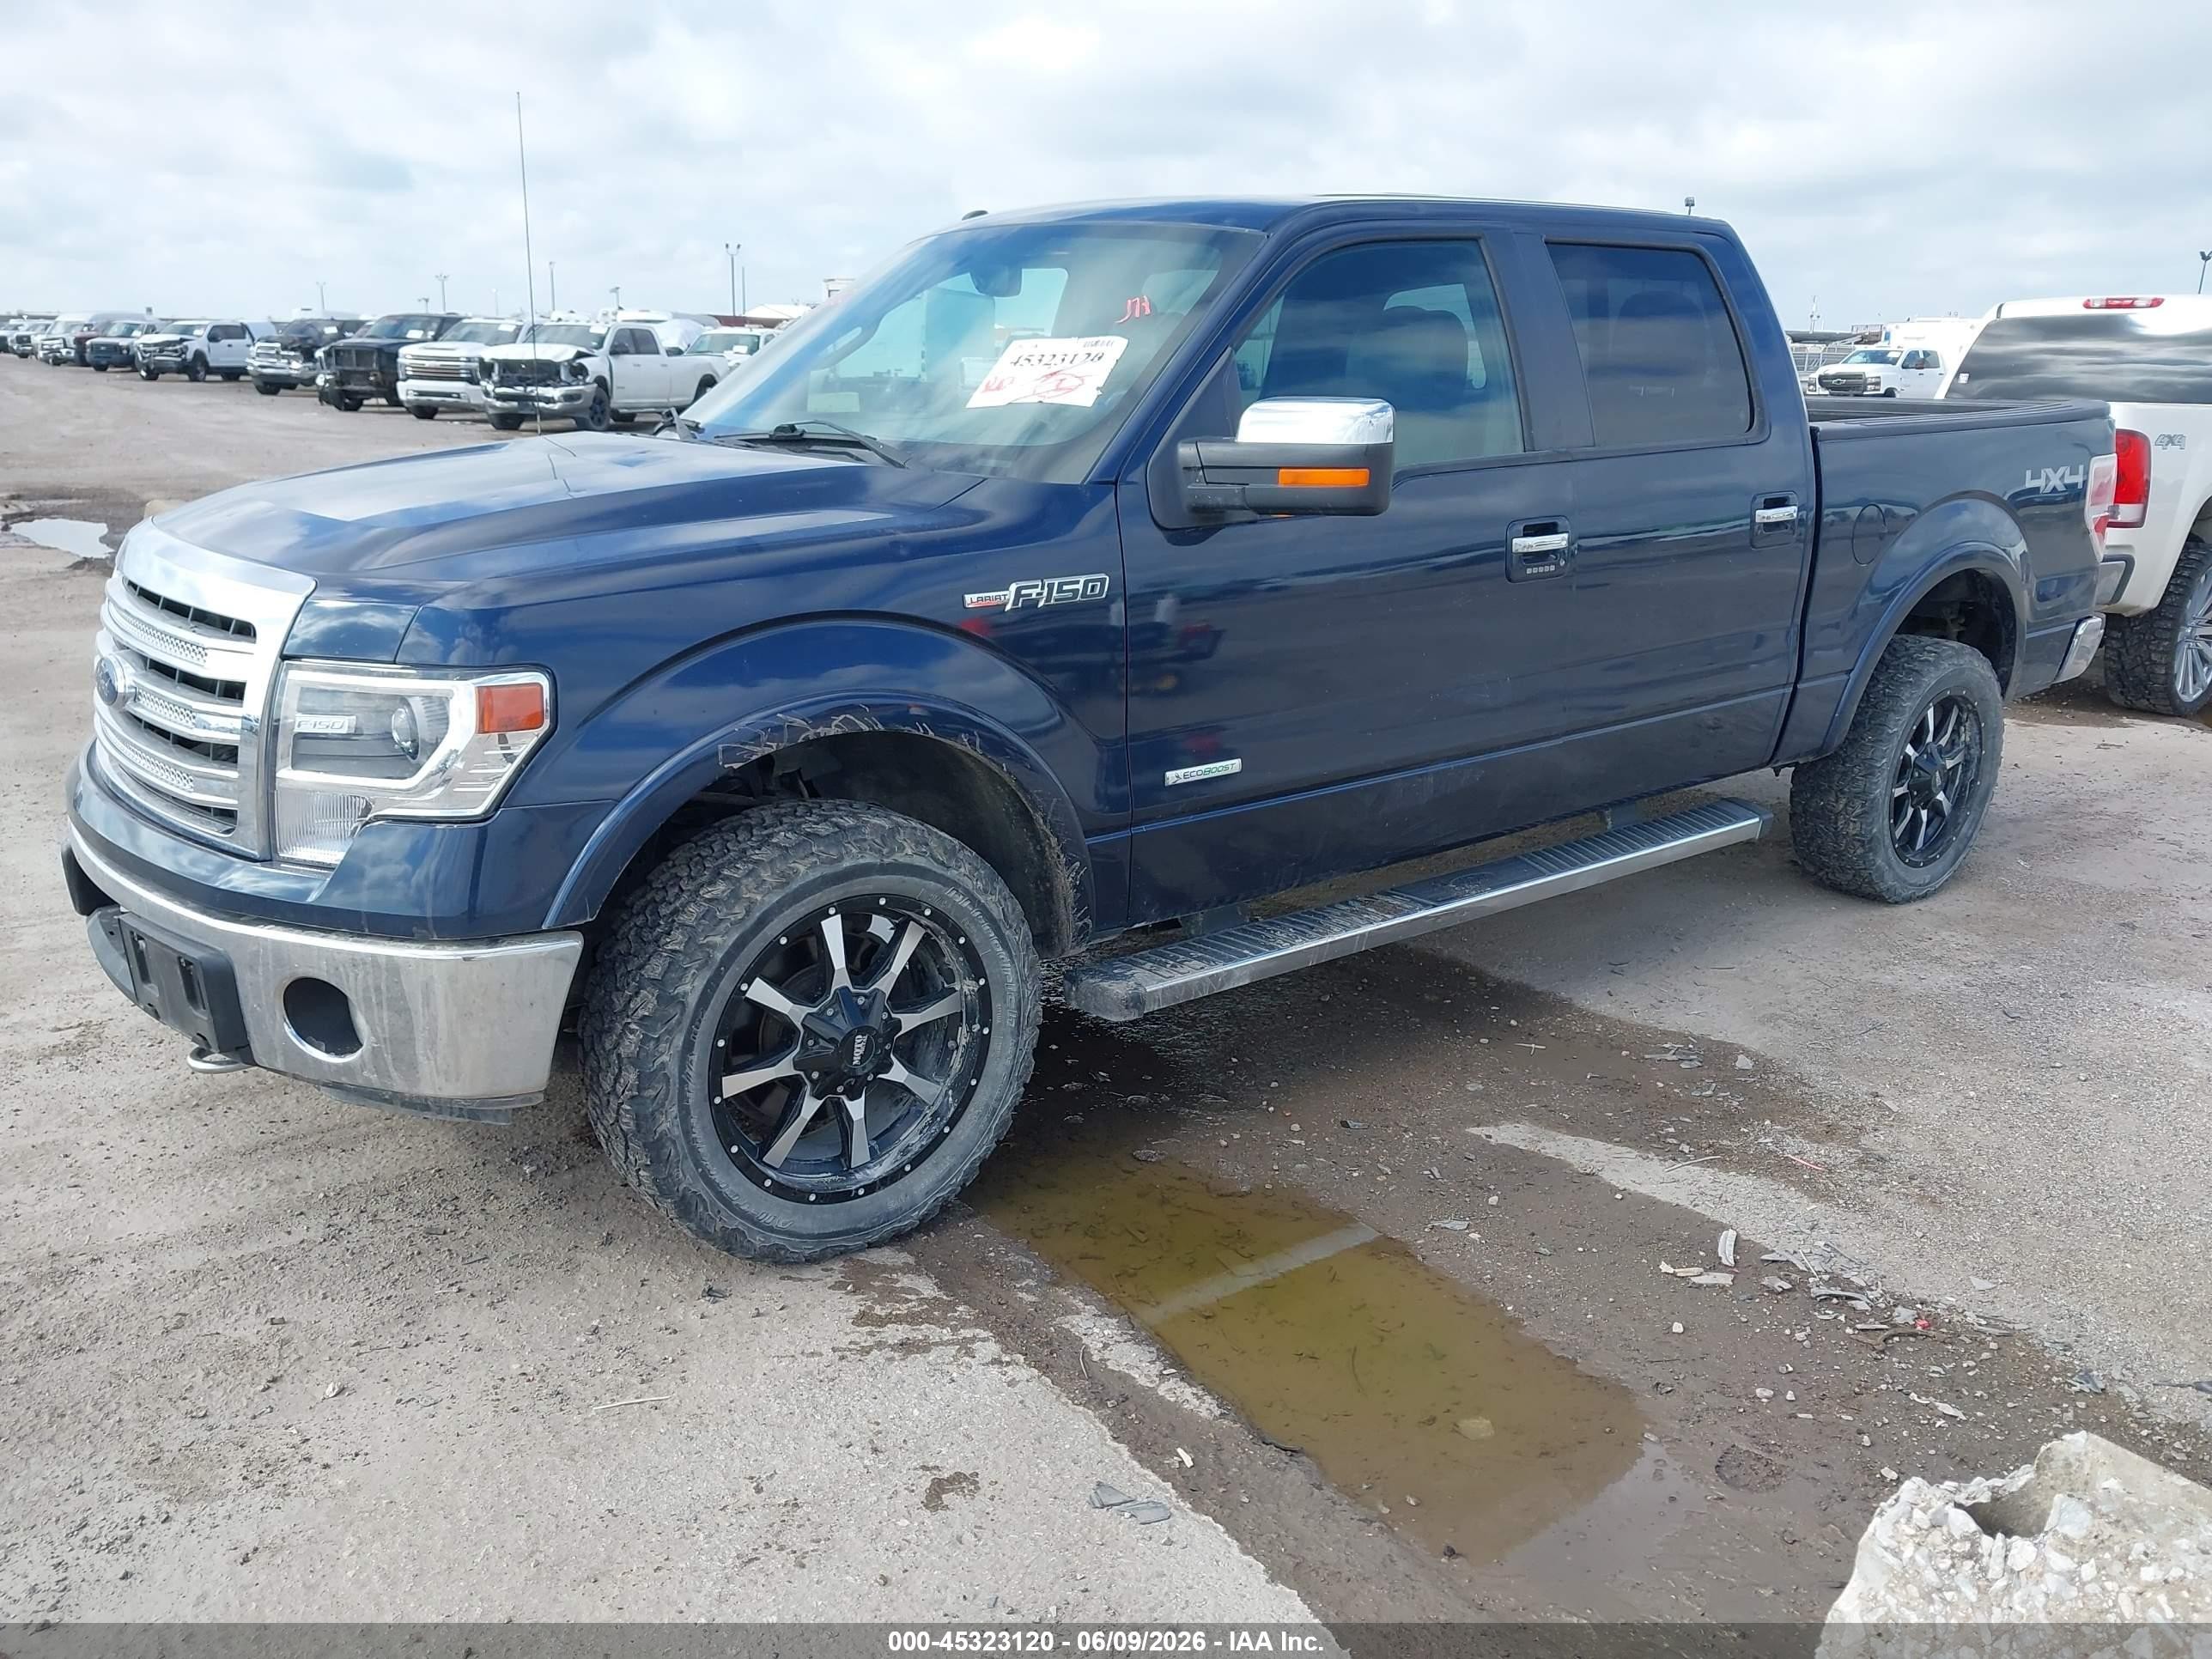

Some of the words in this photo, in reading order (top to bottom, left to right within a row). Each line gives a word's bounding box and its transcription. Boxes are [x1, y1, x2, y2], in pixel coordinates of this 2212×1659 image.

[970, 593, 1008, 605] LARIAT
[1182, 763, 1236, 780] ECOBOOST
[853, 1035, 862, 1066] MOTO
